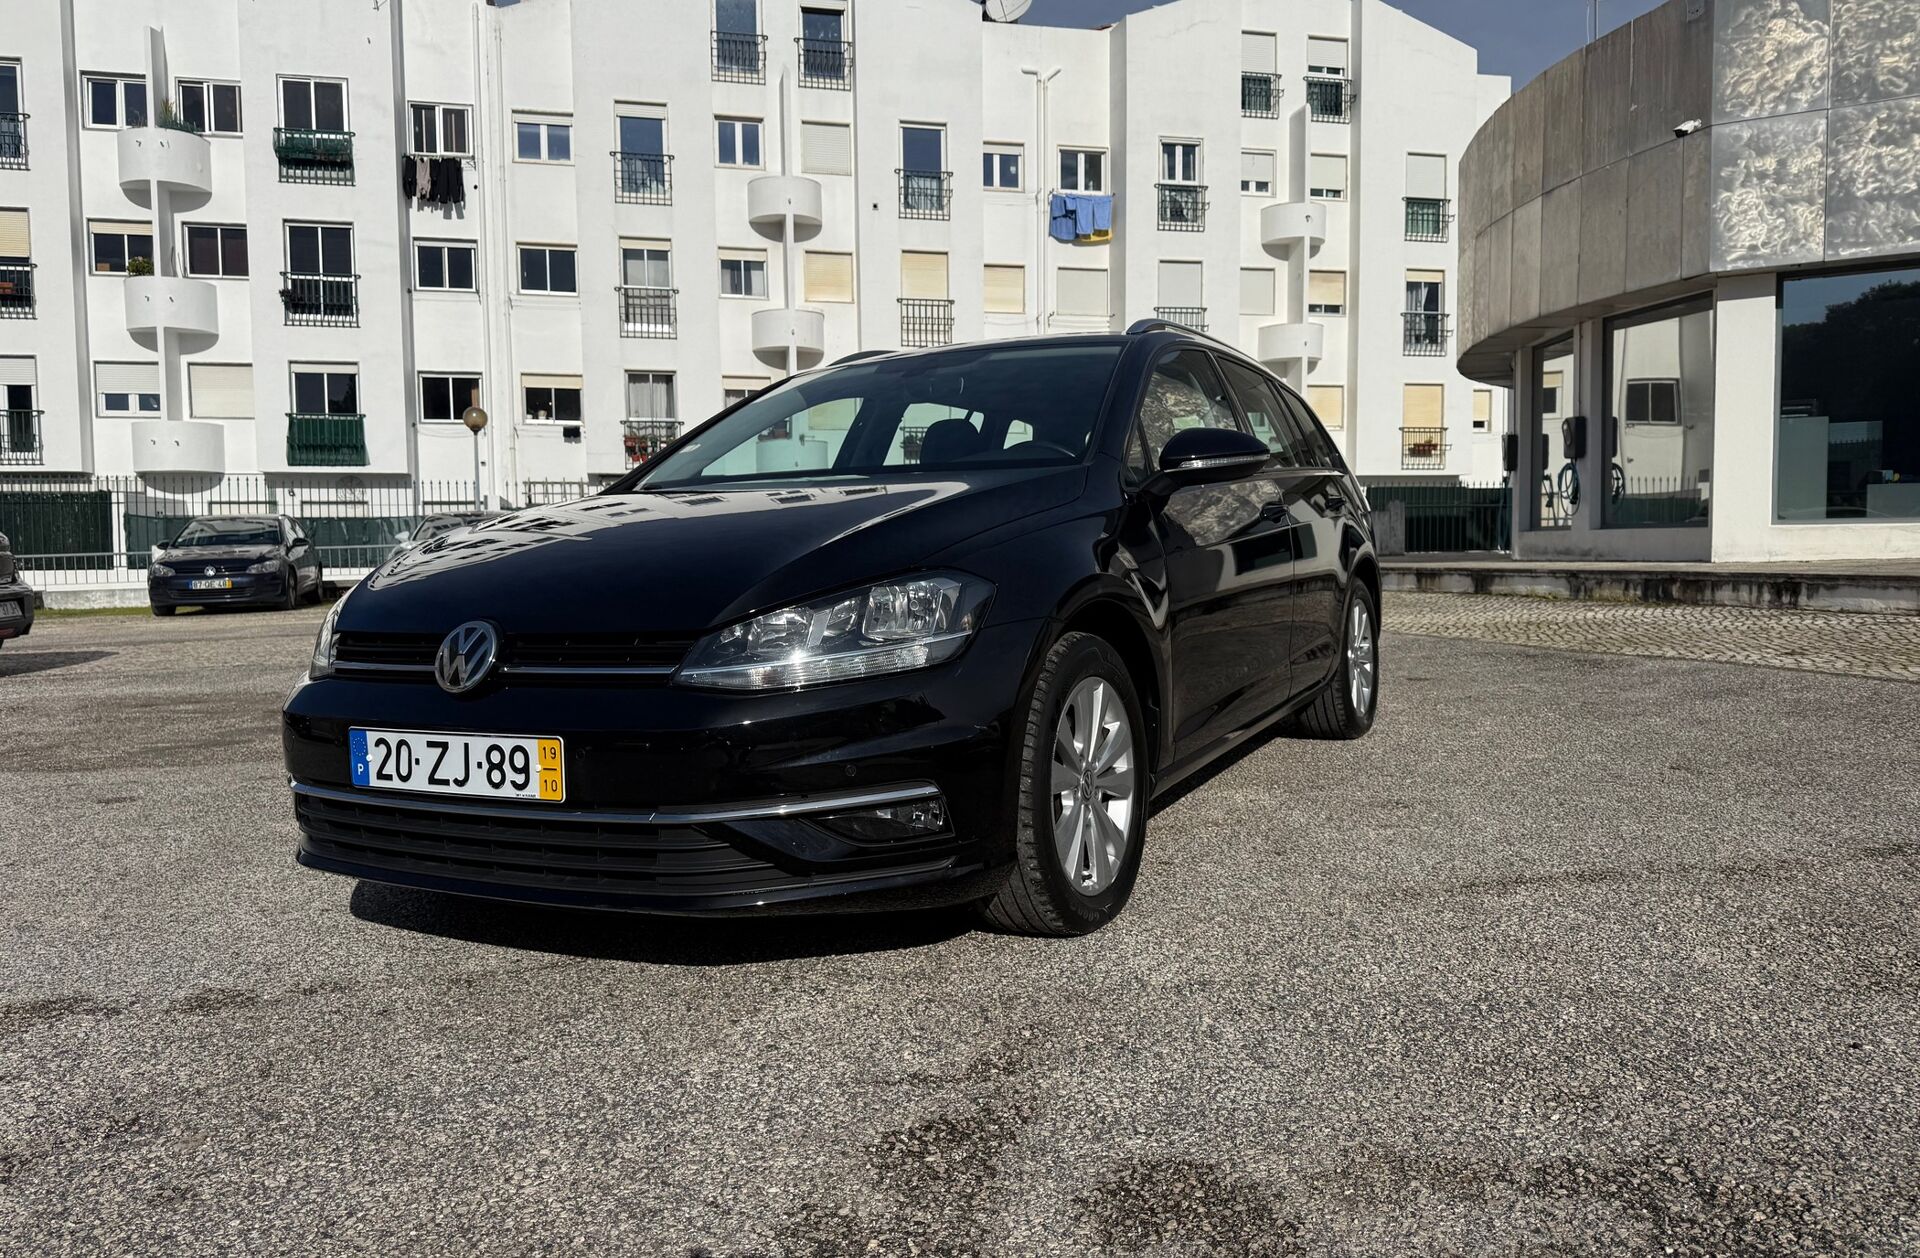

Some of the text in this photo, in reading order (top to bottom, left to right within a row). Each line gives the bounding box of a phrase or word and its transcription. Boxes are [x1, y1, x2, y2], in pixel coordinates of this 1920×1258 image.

[542, 747, 557, 760] 19
[357, 764, 364, 776] P
[544, 779, 558, 792] 10
